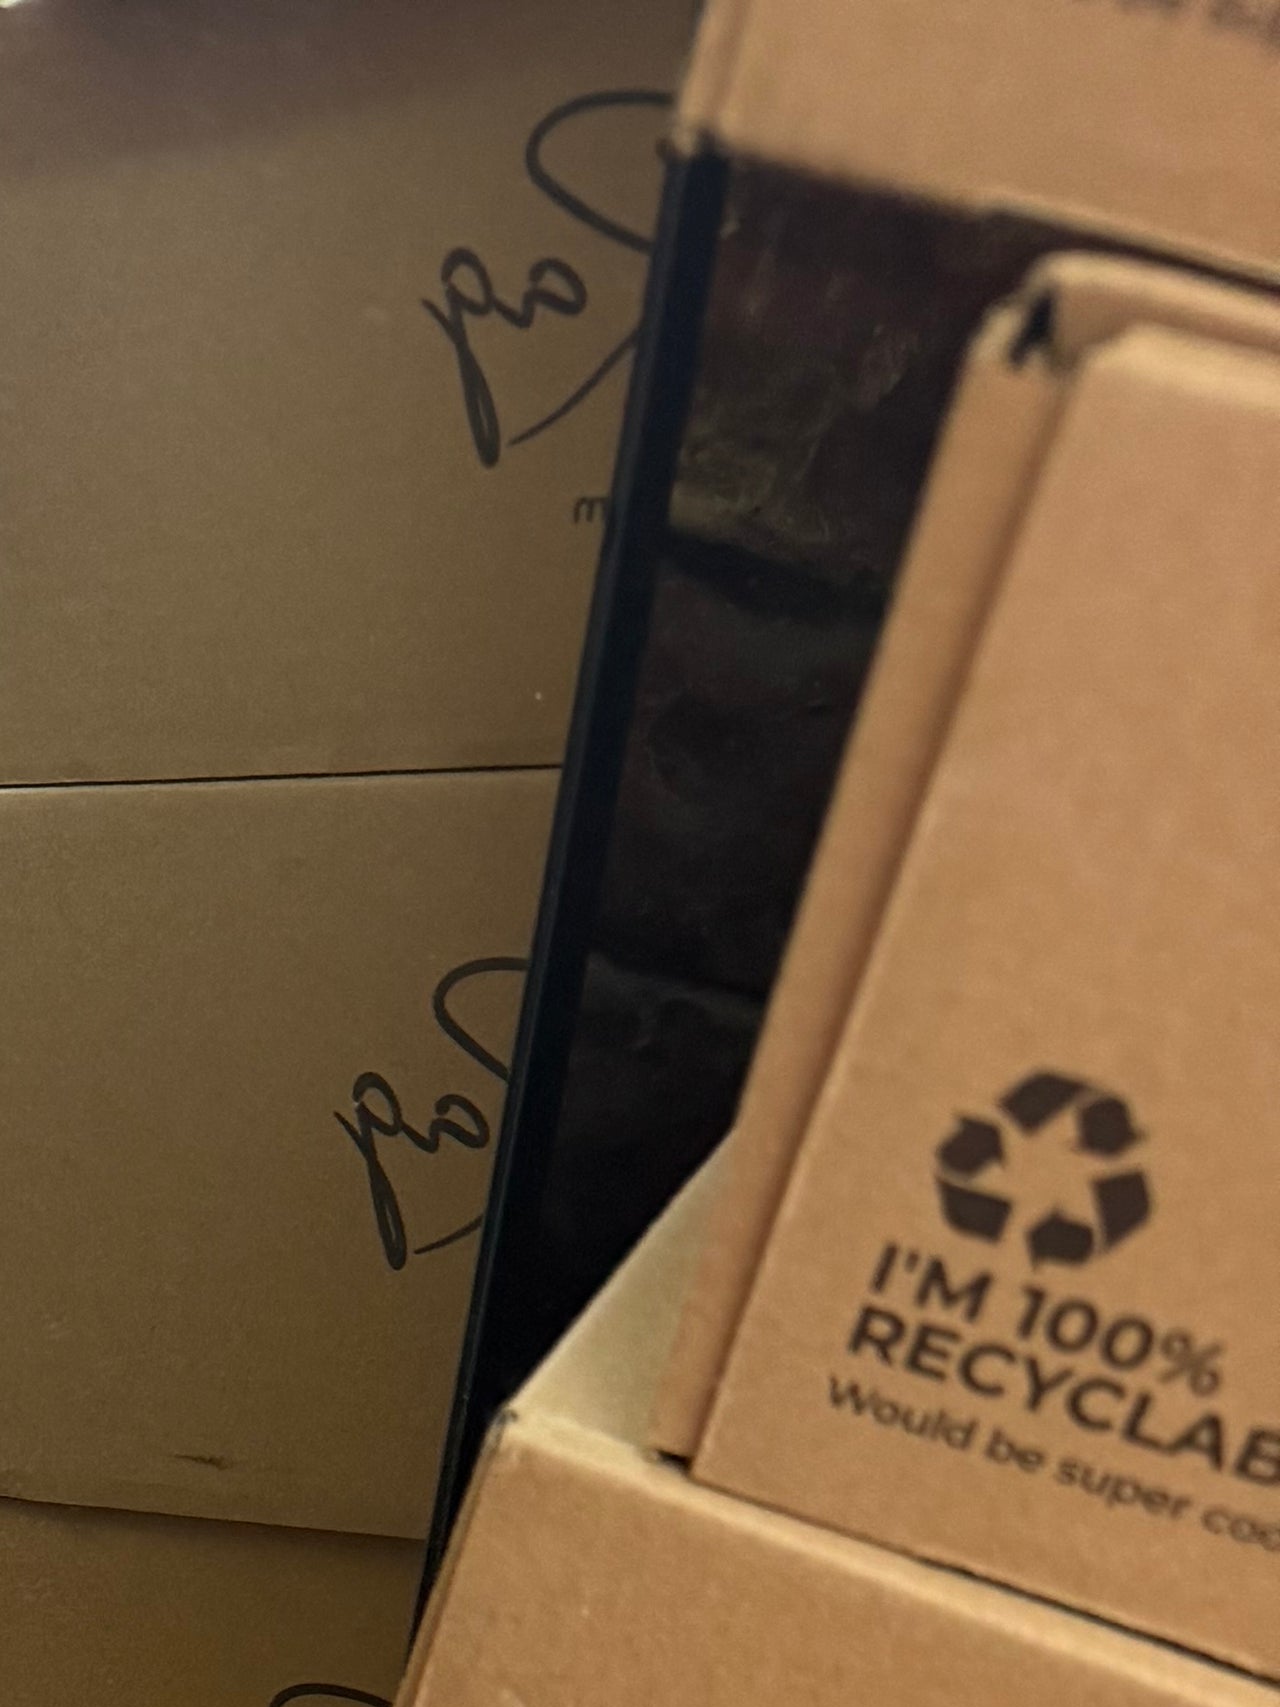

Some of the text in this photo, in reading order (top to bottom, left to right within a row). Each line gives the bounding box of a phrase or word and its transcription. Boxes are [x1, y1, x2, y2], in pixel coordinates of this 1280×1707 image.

[870, 1241, 1225, 1399] I'M 100%
[829, 1375, 979, 1452] Would
[986, 1430, 1046, 1473] be
[1056, 1454, 1191, 1520] super
